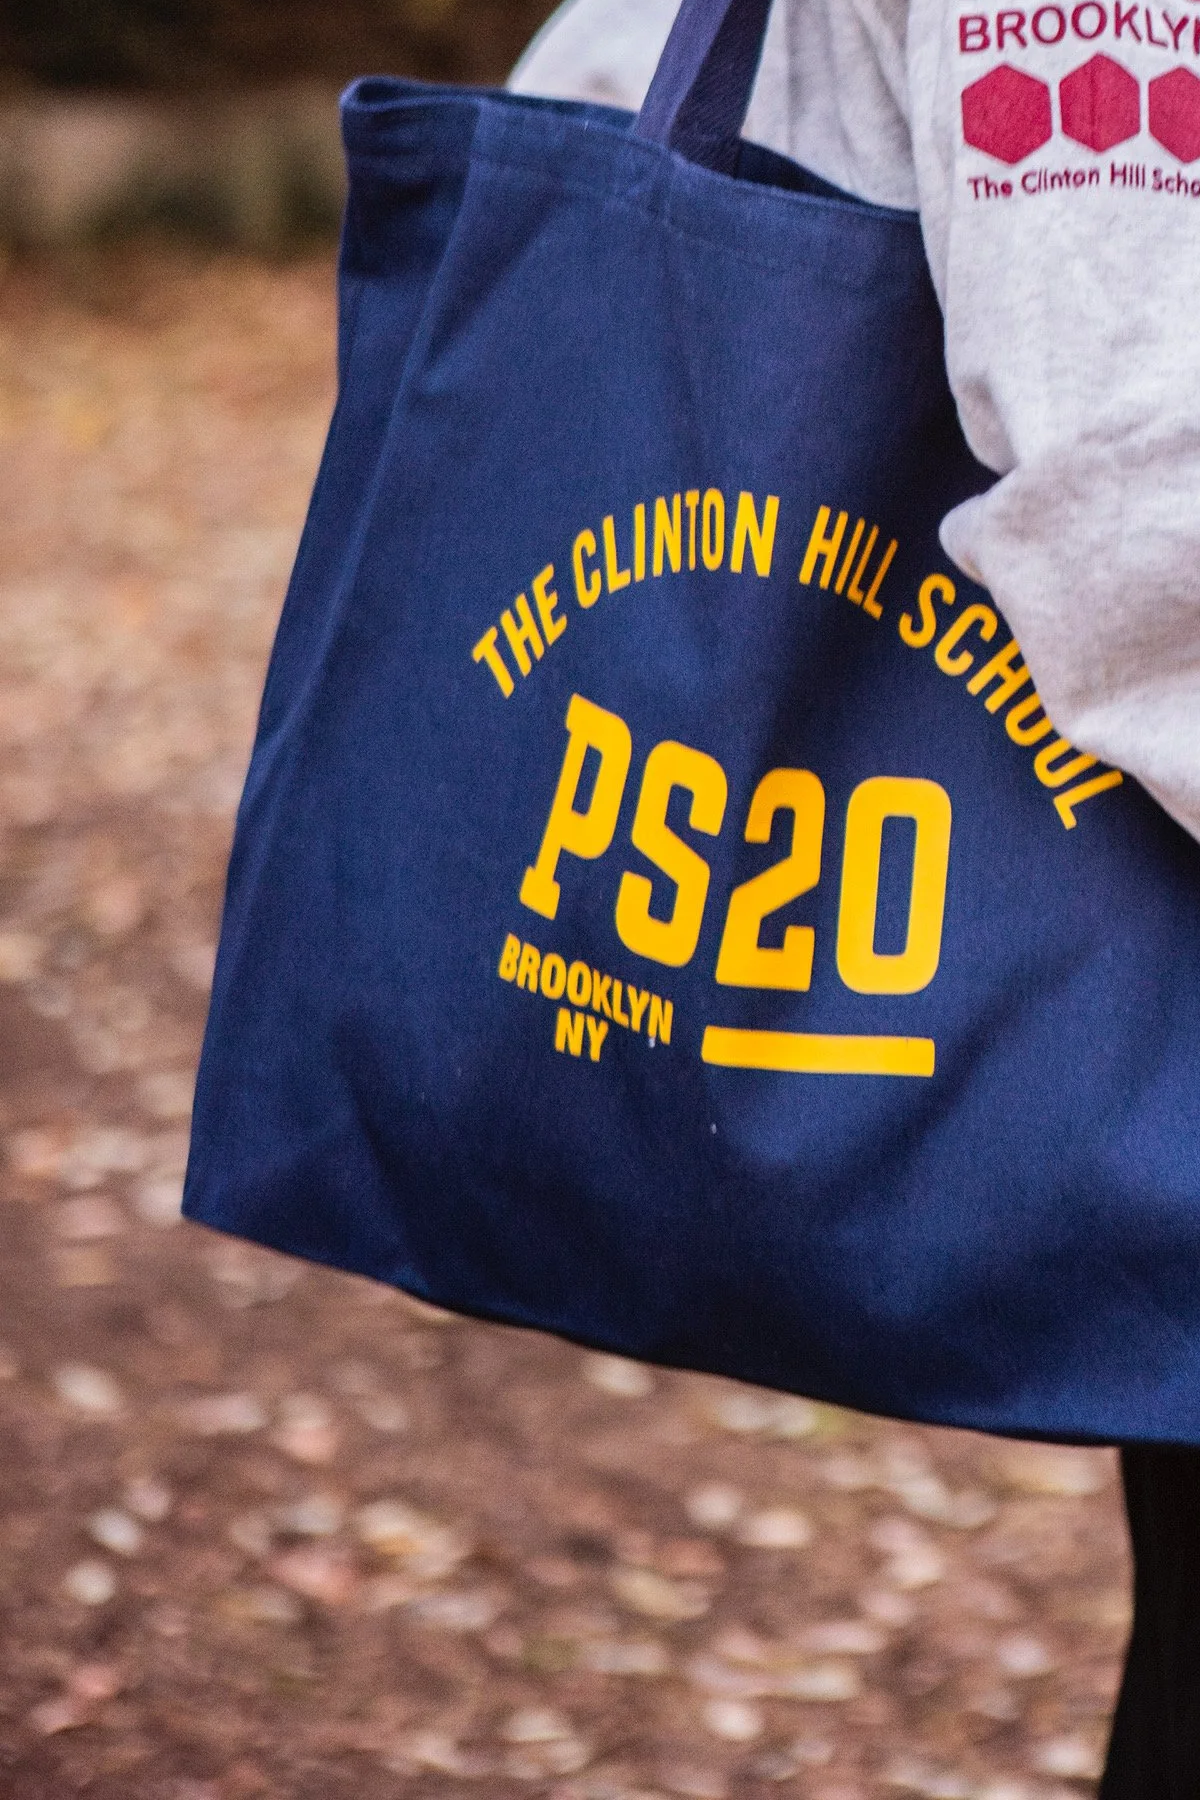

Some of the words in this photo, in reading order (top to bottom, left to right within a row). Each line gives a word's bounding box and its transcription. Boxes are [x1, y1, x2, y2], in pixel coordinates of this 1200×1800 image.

[969, 176, 1012, 199] The
[1021, 166, 1100, 194] Clinton
[1109, 162, 1146, 189] Hill
[472, 564, 568, 699] THE
[573, 488, 780, 609] CLINTON
[800, 505, 898, 620] HILL
[519, 693, 952, 995] PS20
[499, 932, 673, 1045] BROOKLYN
[555, 1007, 609, 1062] NY
